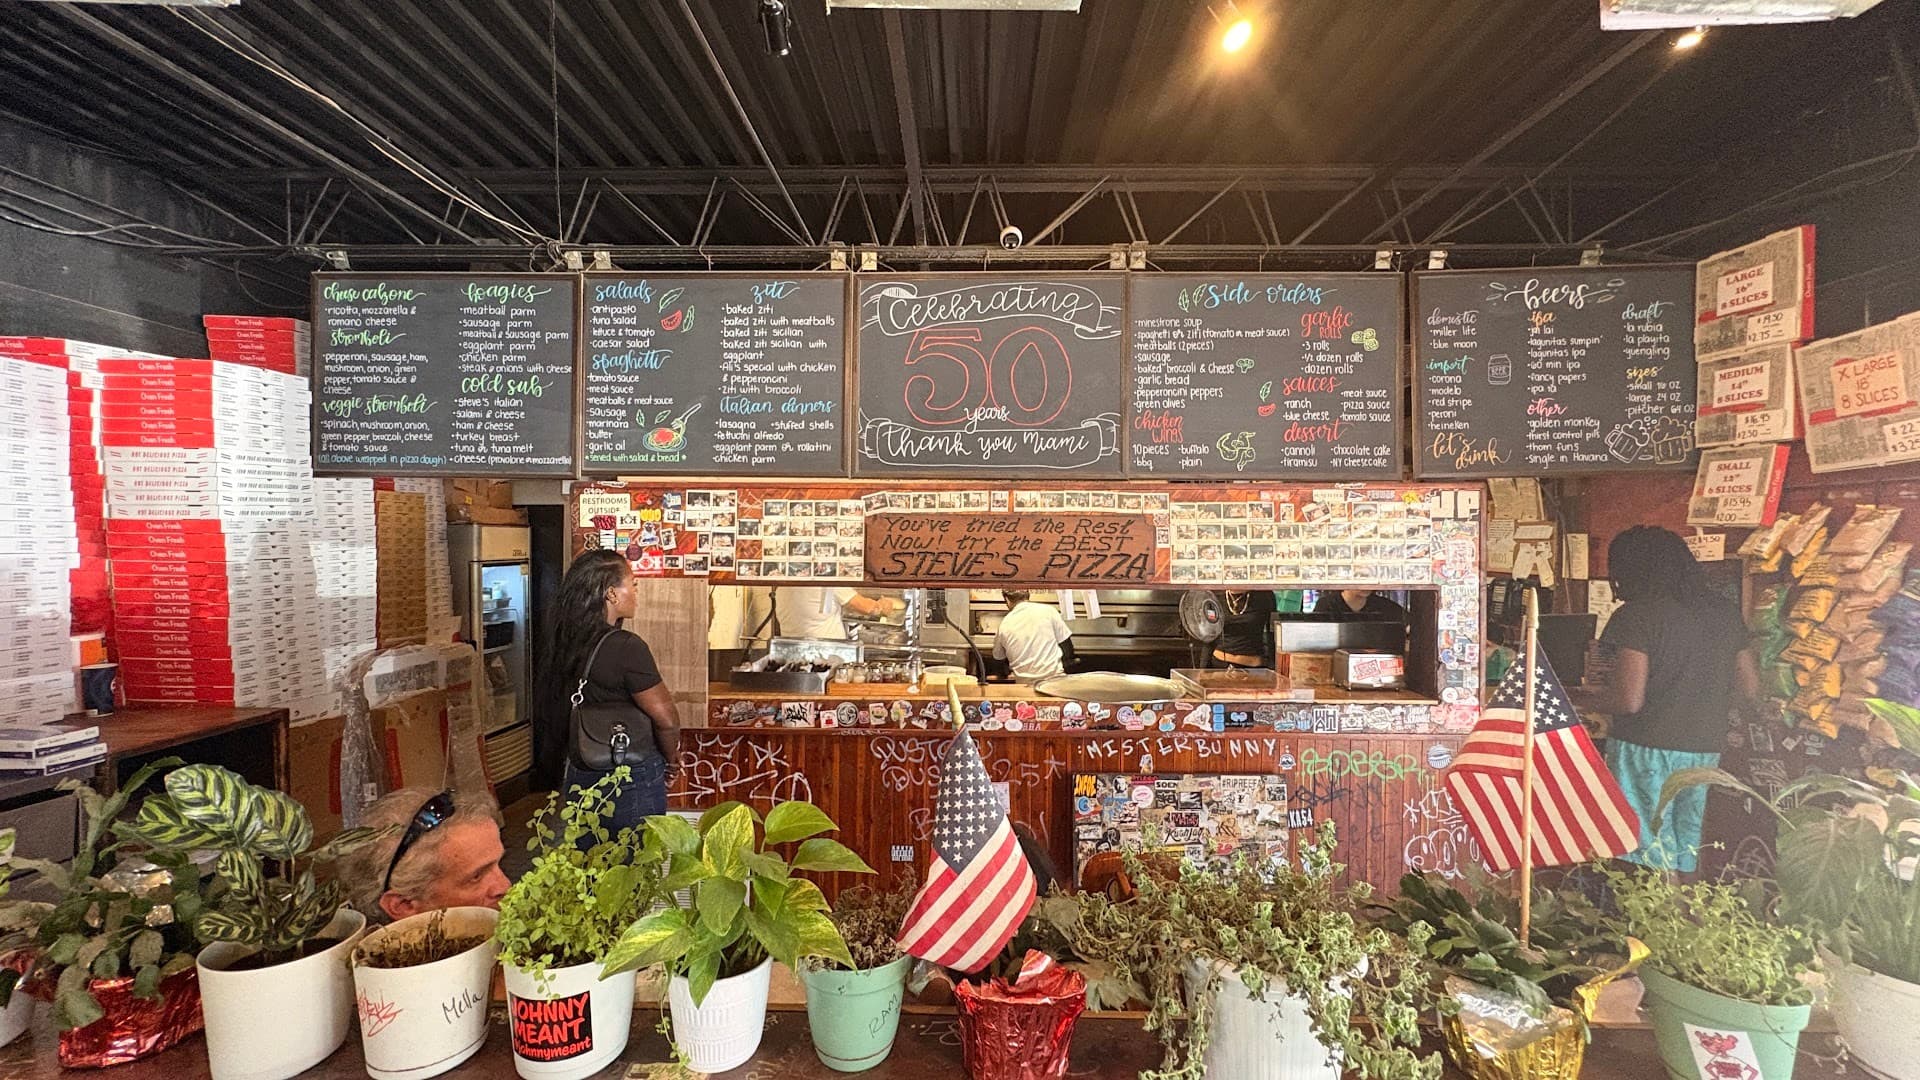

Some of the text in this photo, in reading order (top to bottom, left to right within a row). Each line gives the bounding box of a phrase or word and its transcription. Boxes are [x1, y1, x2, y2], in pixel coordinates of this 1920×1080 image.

[1726, 267, 1764, 285] LARGE
[461, 283, 552, 303] hoagies
[595, 280, 656, 303] salads
[751, 281, 800, 304] ziti
[1267, 283, 1338, 305] orders
[1504, 279, 1610, 310] beers
[1729, 291, 1769, 306] SLICES
[362, 306, 408, 314] mozzarella
[463, 307, 536, 317] meatball parm
[592, 305, 636, 315] antipasto
[889, 285, 1093, 329] Celebrating
[328, 317, 397, 326] romano cheese
[463, 319, 532, 329] sausage parm
[593, 317, 636, 325] tuna salad
[724, 317, 835, 326] baked ziti with meatballs
[1138, 319, 1202, 331] minestrone soup
[1301, 306, 1353, 338] garlic
[1433, 328, 1457, 336] miller
[1638, 323, 1662, 332] rubia
[331, 328, 407, 346] stromboli
[463, 342, 536, 353] eggplant parm
[1313, 341, 1329, 351] rolls
[1433, 340, 1448, 349] blue
[592, 350, 673, 373] spaghetti
[1137, 353, 1171, 364] sausage
[1719, 366, 1764, 382] MEDIUM
[1838, 355, 1897, 381] X LARGE
[904, 327, 1072, 426] 50
[1432, 375, 1461, 384] corona
[1626, 366, 1664, 384] sizes
[462, 374, 553, 397] cold sub
[1137, 376, 1190, 388] garlic bread
[1283, 376, 1341, 396] sauces
[1137, 387, 1223, 400] pepperoncini peppers
[1431, 387, 1461, 395] modelo
[1724, 389, 1763, 402] SLICES
[1432, 398, 1472, 409] red stripe
[1628, 394, 1652, 406] large
[1841, 386, 1899, 409] 8 SLICES
[323, 394, 438, 418] veggie stromboli
[781, 398, 836, 414] dinners
[1136, 400, 1185, 411] green olives
[1286, 401, 1311, 409] ranch
[1343, 401, 1390, 410] pizza sauce
[1527, 398, 1567, 417] other
[589, 408, 626, 419] sausage
[775, 421, 833, 429] stuffed shells
[964, 406, 1010, 434] years
[1430, 421, 1469, 429] heineken
[1529, 419, 1560, 431] golden
[719, 421, 756, 434] lasagna
[1284, 420, 1348, 442] dessert
[455, 432, 520, 444] turkey breast
[589, 431, 613, 439] butter
[589, 442, 626, 453] garlic oil
[977, 436, 1017, 460] you
[1024, 431, 1089, 457] Miami
[1181, 446, 1209, 454] buffalo
[1285, 447, 1315, 456] cannoli
[1334, 446, 1391, 456] chocolate cake
[1137, 458, 1153, 471] bbq
[1182, 458, 1202, 467] plain
[1284, 458, 1317, 467] tiramisu
[1716, 462, 1752, 472] SMALL
[1715, 485, 1753, 494] SLICES
[582, 497, 628, 505] RESTROOMS
[884, 516, 1136, 535] You've tried the Rest
[1007, 535, 1043, 551] the
[1052, 535, 1133, 551] BEST
[882, 551, 1150, 579] STEVE'S PIZZA
[511, 993, 589, 1023] JOHNNY
[514, 1017, 585, 1045] MEANT
